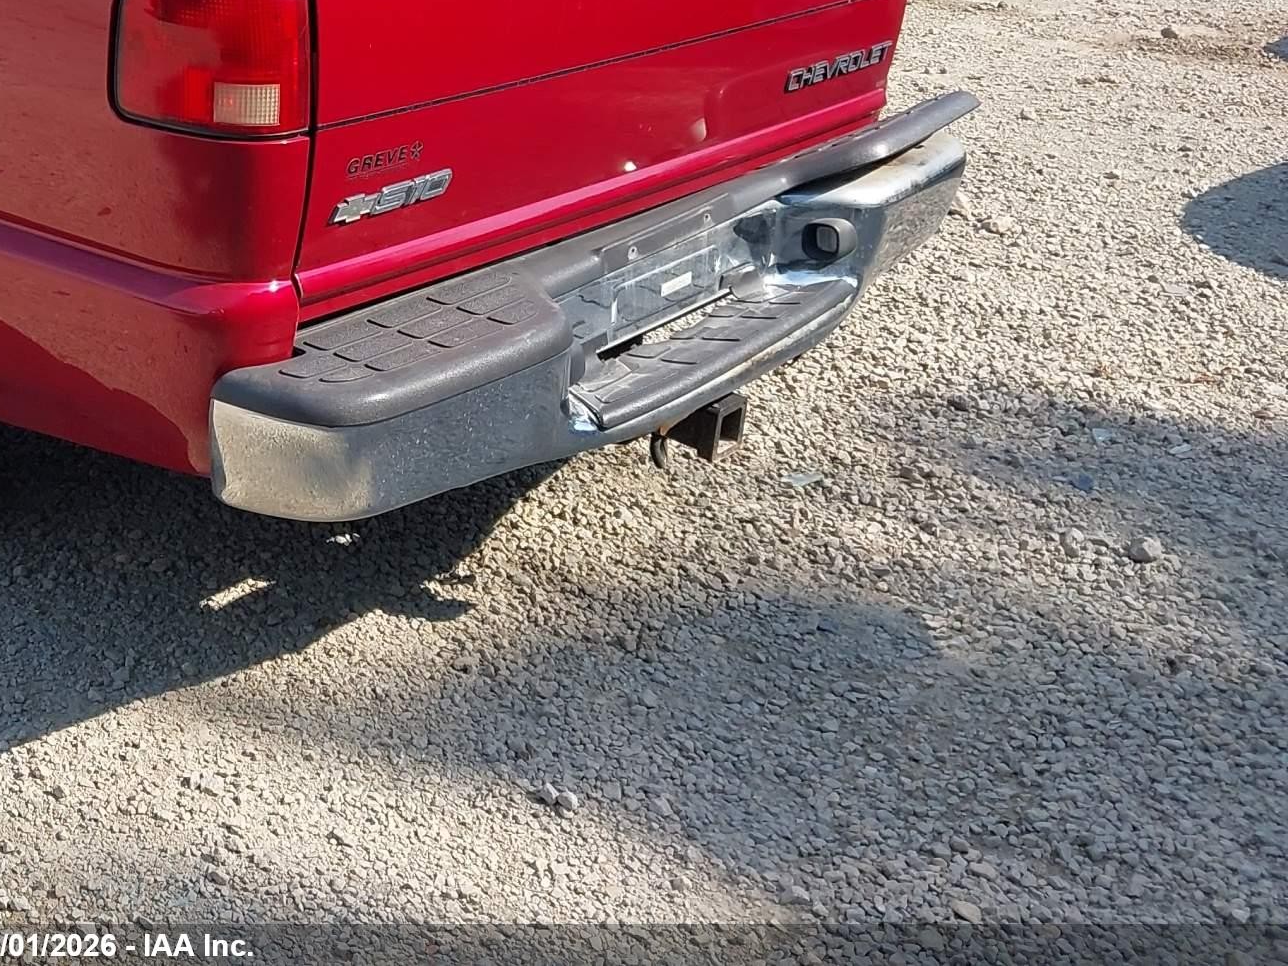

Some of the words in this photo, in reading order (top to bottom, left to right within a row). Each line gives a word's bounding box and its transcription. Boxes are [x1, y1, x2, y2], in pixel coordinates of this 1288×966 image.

[785, 40, 893, 92] CHEVROLET
[347, 144, 409, 176] GREVE
[372, 168, 453, 215] S10
